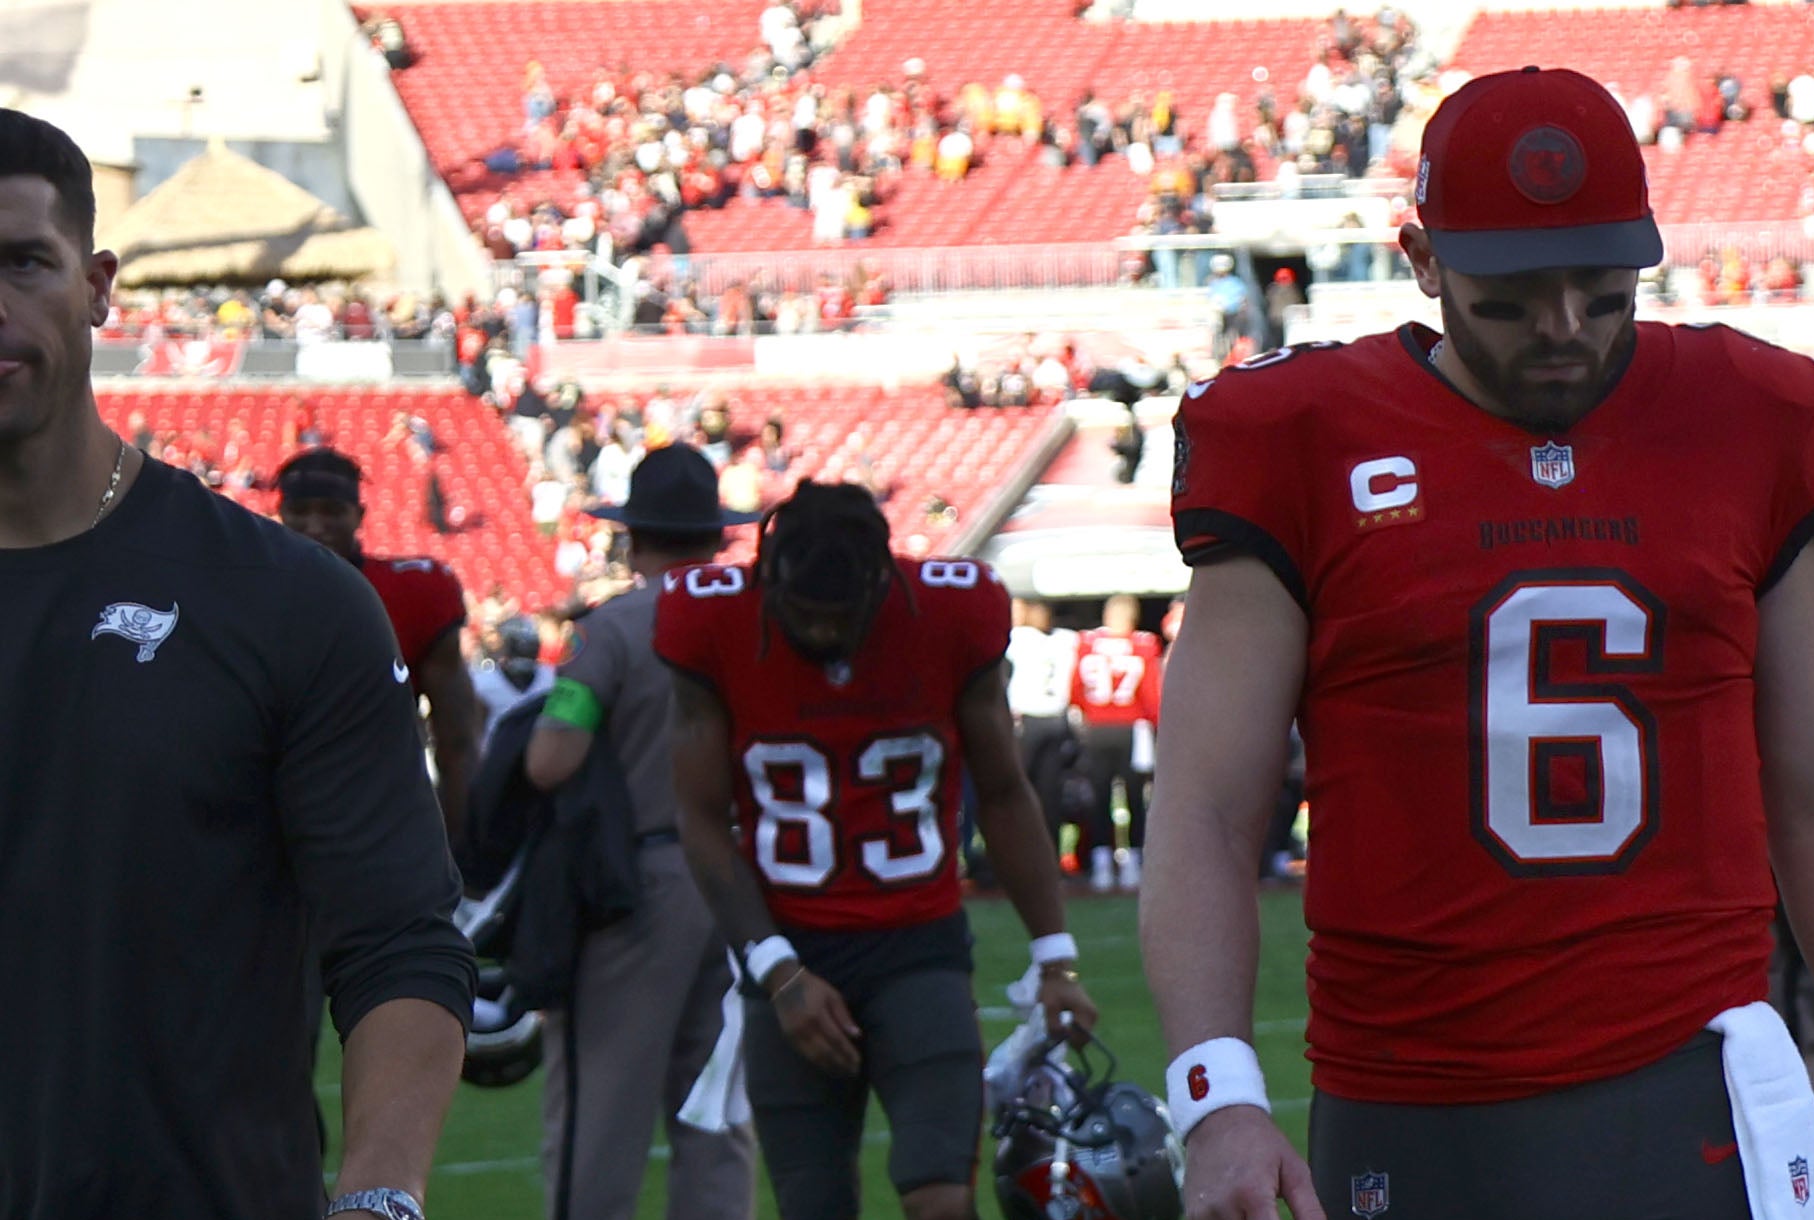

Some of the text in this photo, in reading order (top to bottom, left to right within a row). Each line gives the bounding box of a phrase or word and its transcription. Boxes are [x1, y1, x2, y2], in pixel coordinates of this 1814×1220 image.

[1349, 455, 1418, 513] C
[1539, 461, 1569, 480] NFL
[1479, 516, 1639, 549] BUCCANEERS
[920, 560, 978, 588] 8
[1079, 653, 1145, 707] 97
[1481, 578, 1655, 866] 6
[743, 732, 944, 887] 83
[1187, 1064, 1210, 1101] 6
